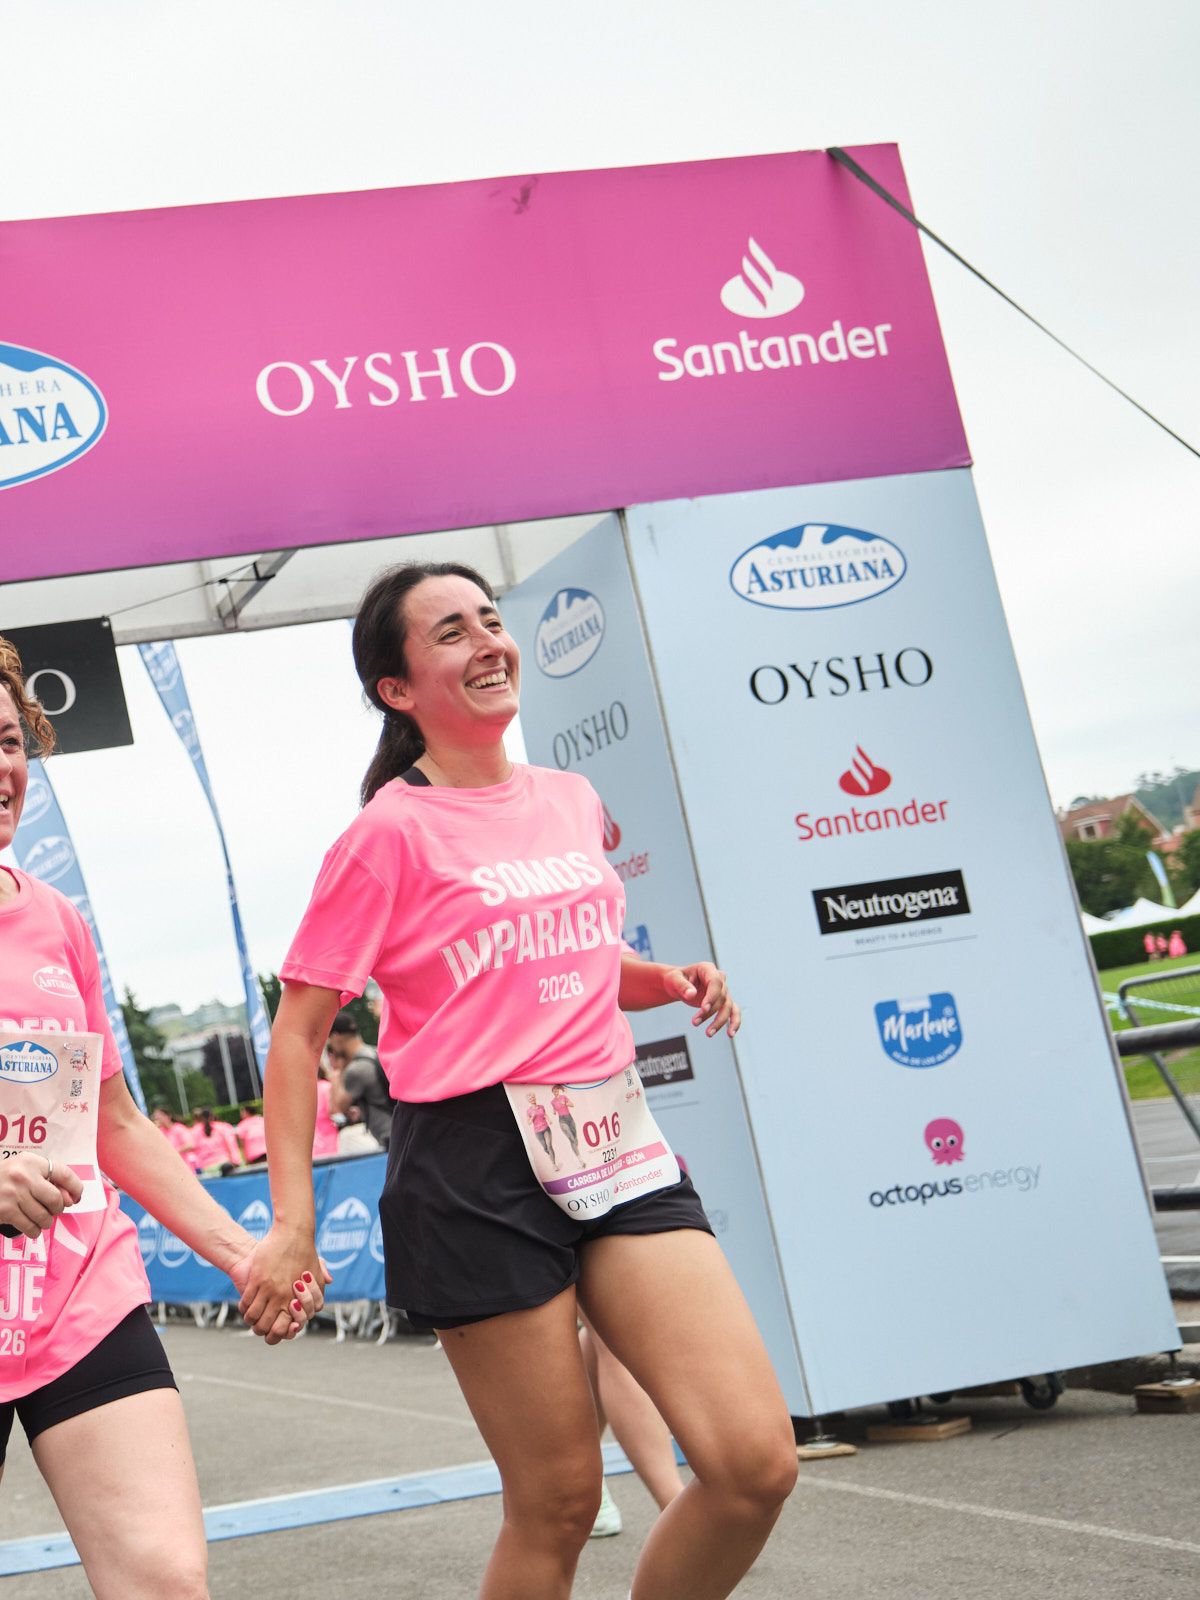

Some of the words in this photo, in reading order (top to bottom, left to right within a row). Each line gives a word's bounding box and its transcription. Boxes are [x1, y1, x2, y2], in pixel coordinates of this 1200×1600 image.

[652, 320, 893, 382] Santander
[255, 341, 518, 417] OYSHO
[747, 558, 896, 594] ASTURIANA
[767, 552, 824, 566] CENTRAL
[829, 545, 886, 560] LECHERA
[541, 614, 602, 668] ASTURIANA
[749, 647, 934, 705] OYSHO
[553, 701, 628, 771] OYSHO
[795, 798, 949, 841] Santander
[472, 851, 603, 907] SOMOS
[822, 886, 959, 923] Neutrogena
[538, 971, 585, 1004] 2026
[883, 1010, 958, 1053] Marlene
[582, 1112, 620, 1148] 016
[567, 1189, 610, 1212] OYSHO
[619, 1168, 663, 1191] Santander
[568, 1171, 601, 1188] CARRERA
